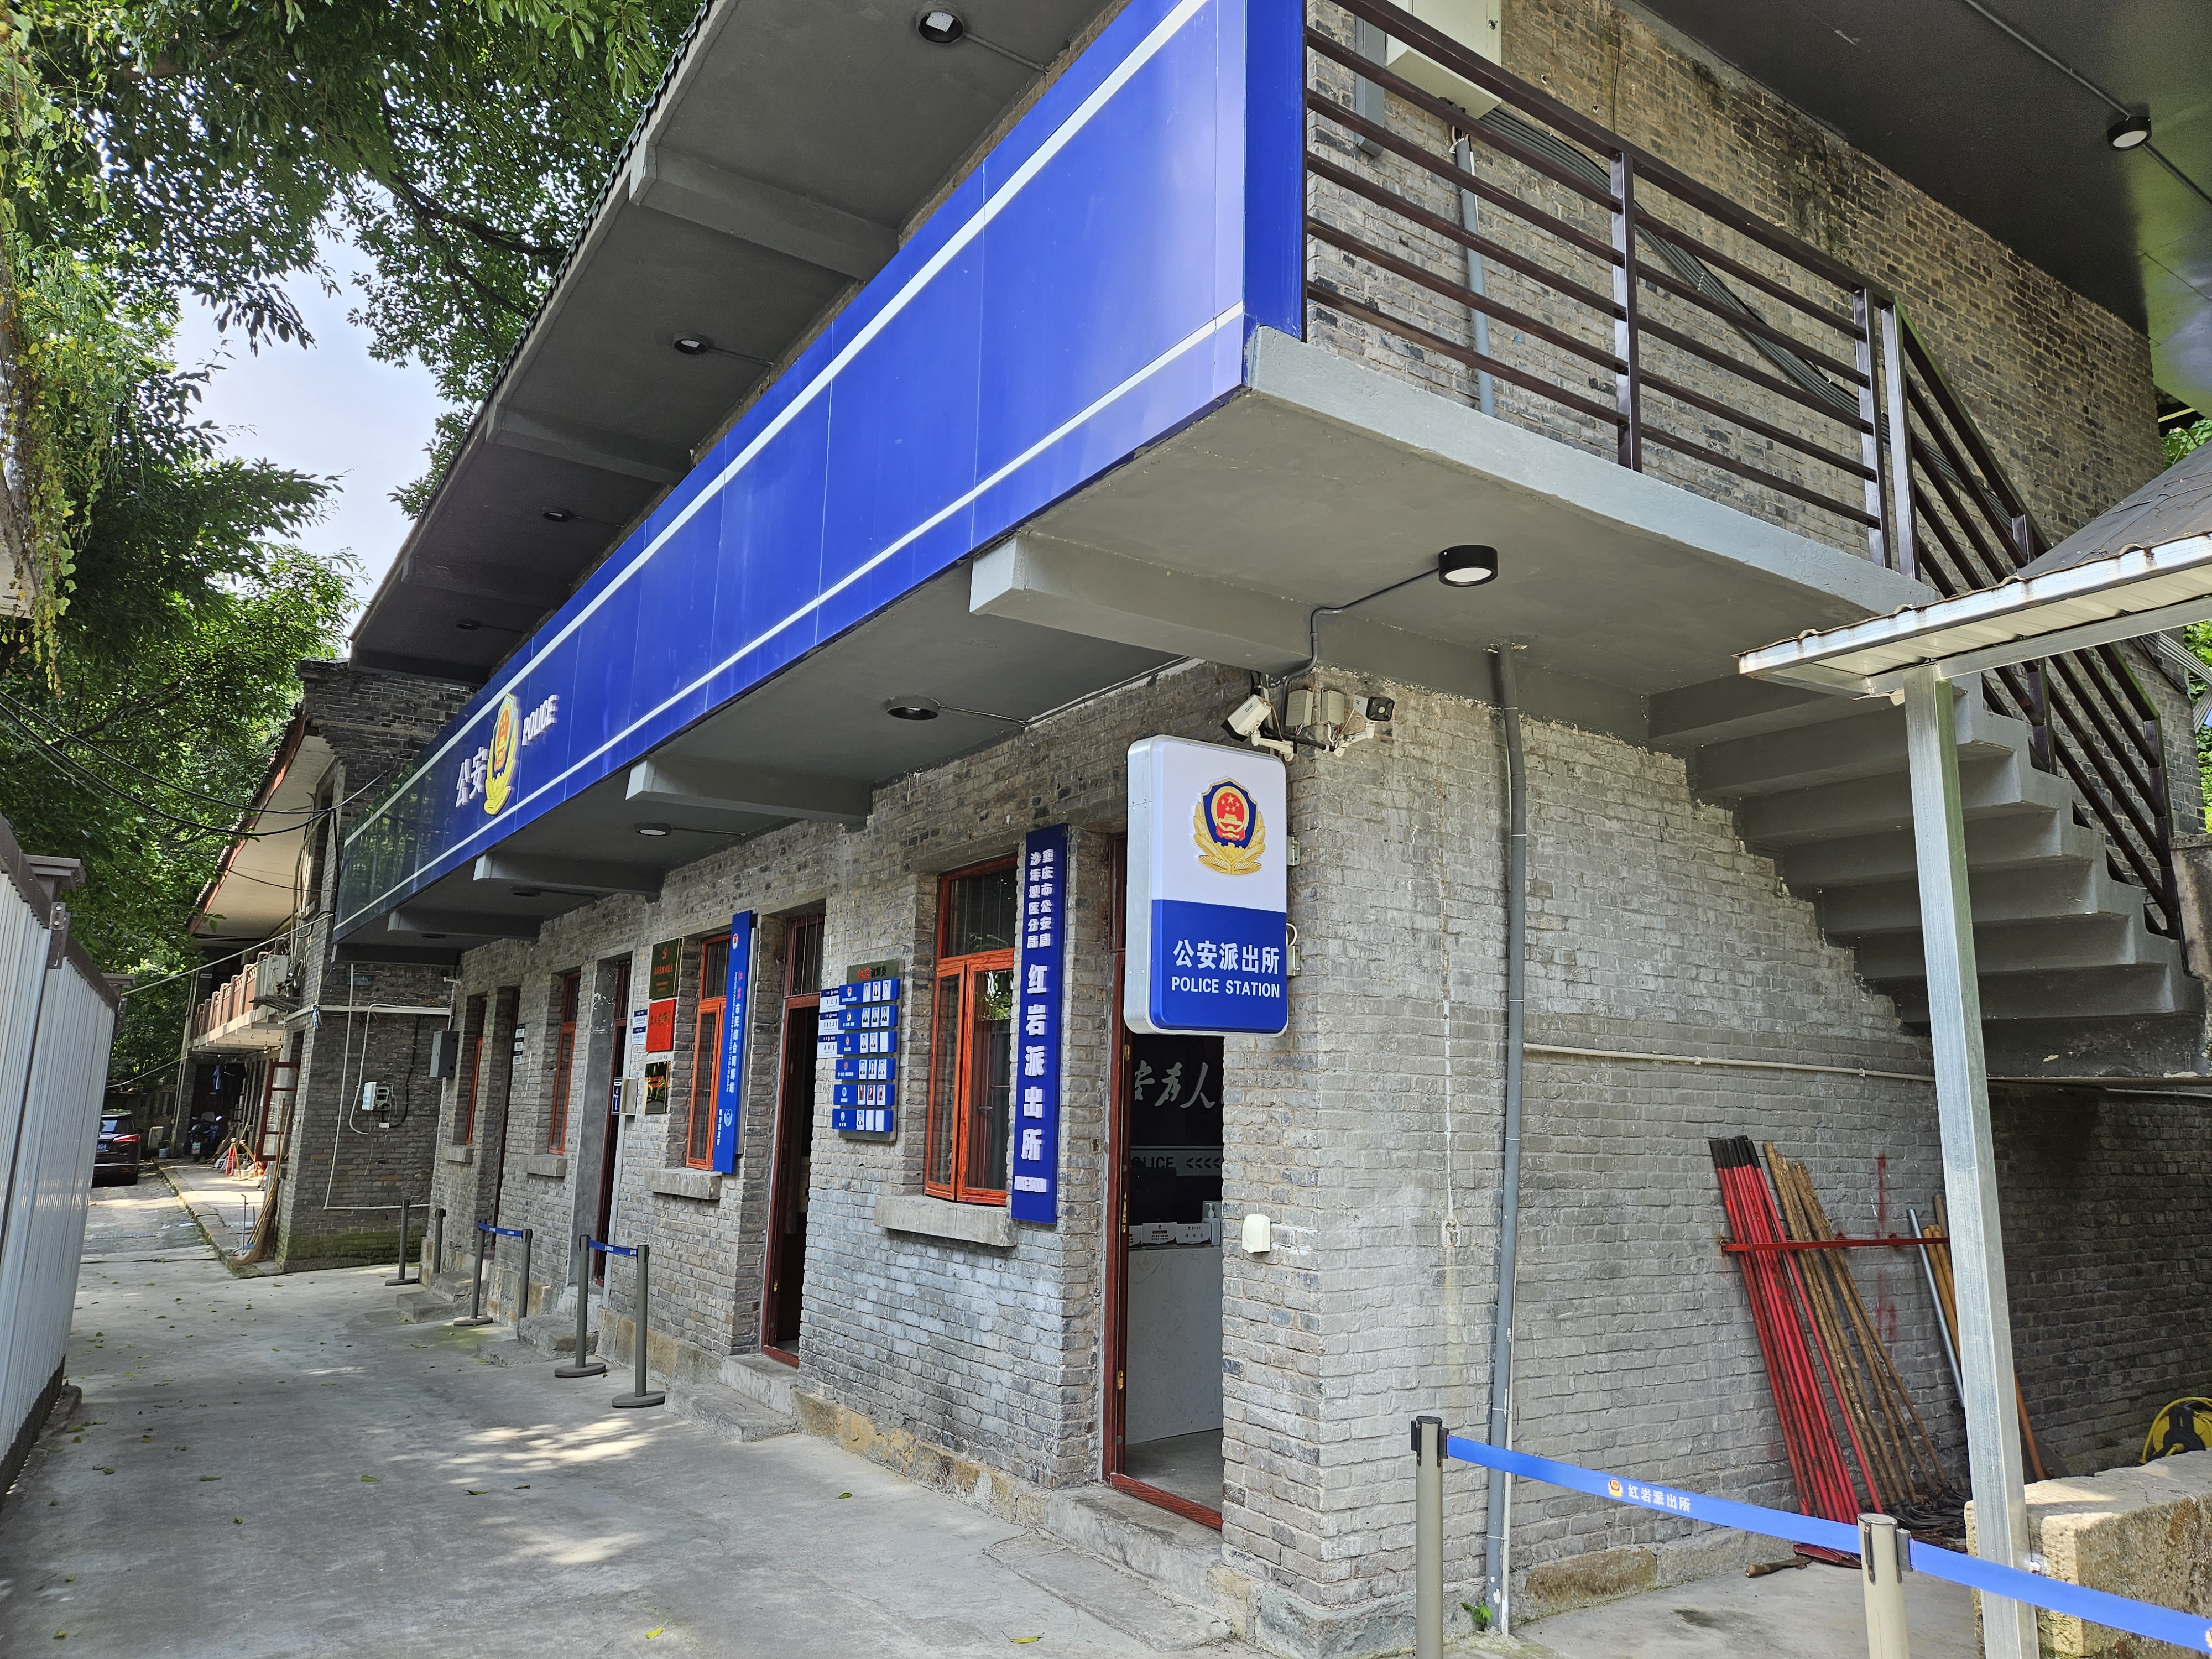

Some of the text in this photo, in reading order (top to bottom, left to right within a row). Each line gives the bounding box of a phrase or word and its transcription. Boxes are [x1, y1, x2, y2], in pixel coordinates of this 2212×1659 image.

[522, 694, 559, 746] POLICE
[456, 747, 488, 808] 公安
[1027, 852, 1042, 948] 沙坪坝区分局
[1040, 848, 1054, 947] 重庆市公安局
[1173, 939, 1280, 975] 公安派出所
[1172, 976, 1280, 998] POLICE STATION
[1021, 964, 1047, 1160] 红岩派出所
[1627, 1484, 1691, 1512] 红岩派出所
